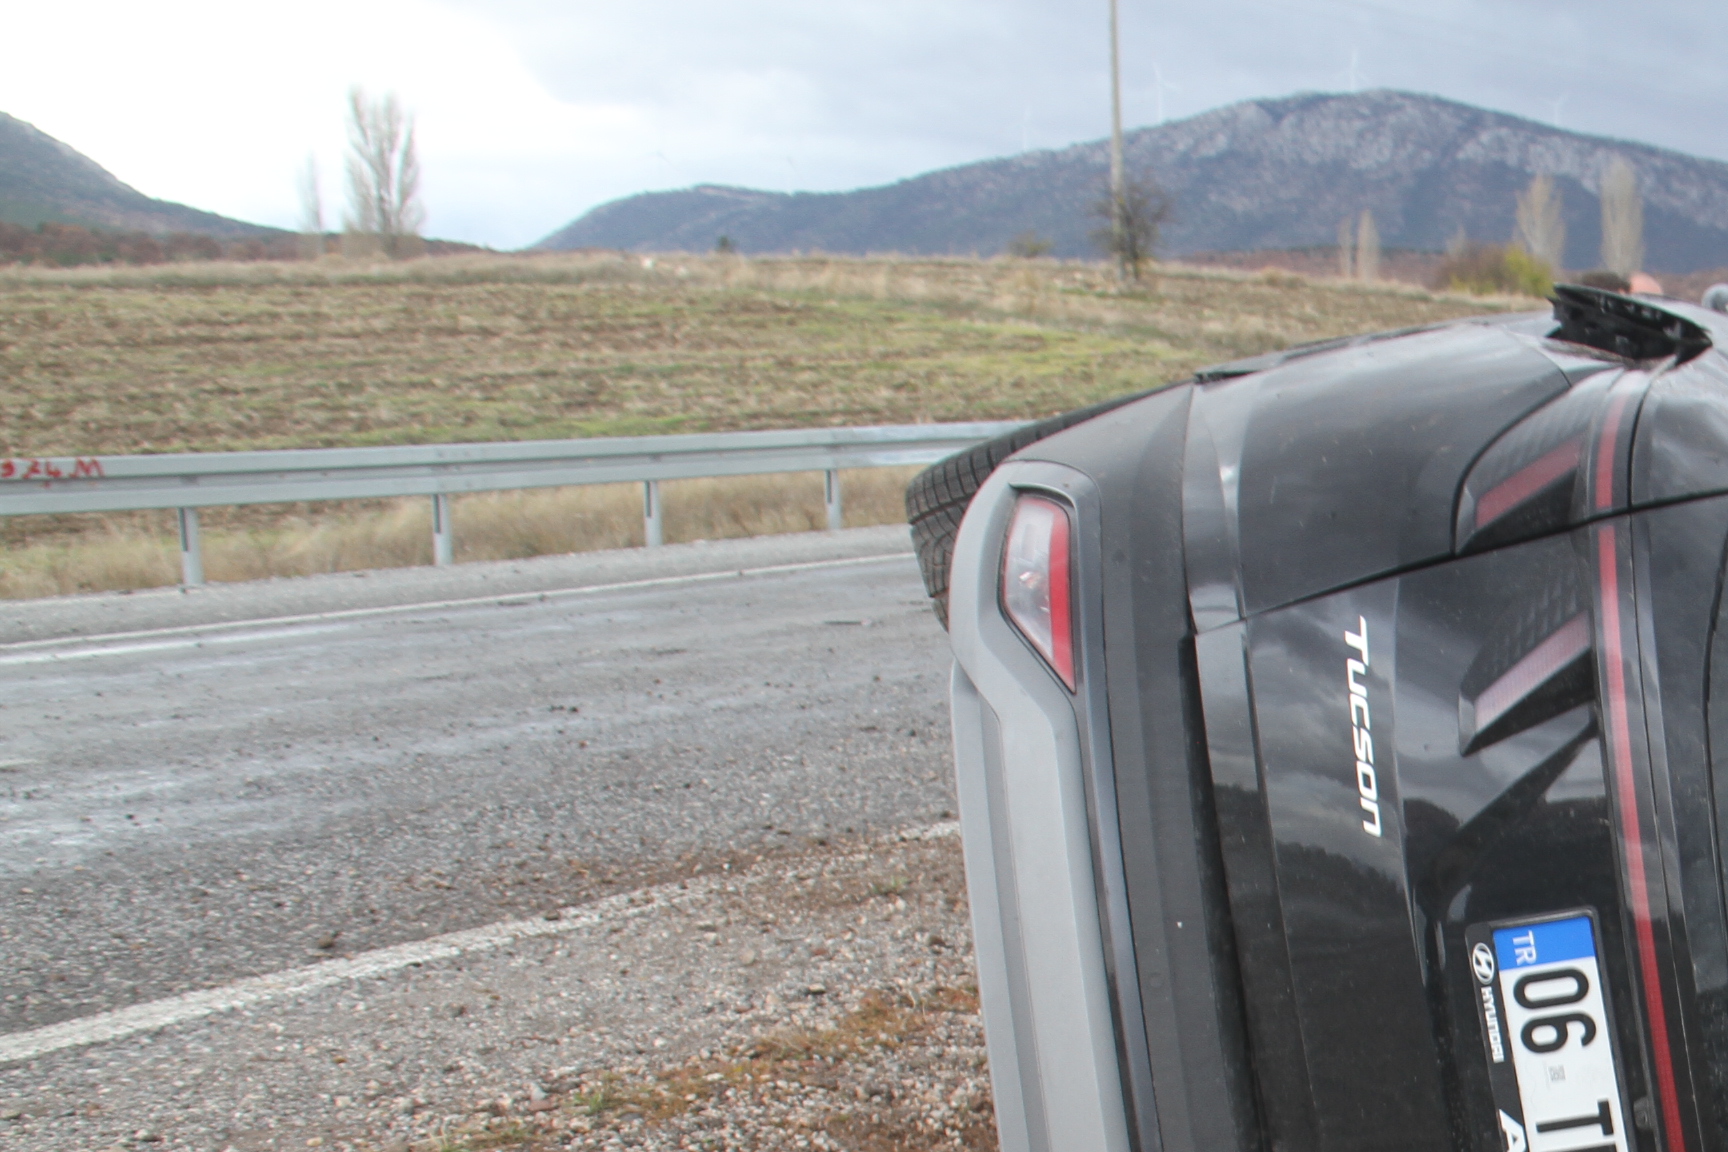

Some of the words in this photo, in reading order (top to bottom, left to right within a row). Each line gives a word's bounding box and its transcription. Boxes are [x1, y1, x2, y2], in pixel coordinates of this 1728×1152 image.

[1511, 930, 1537, 965] TR
[1480, 987, 1504, 1063] HYUNDAI
[1513, 966, 1597, 1054] 06
